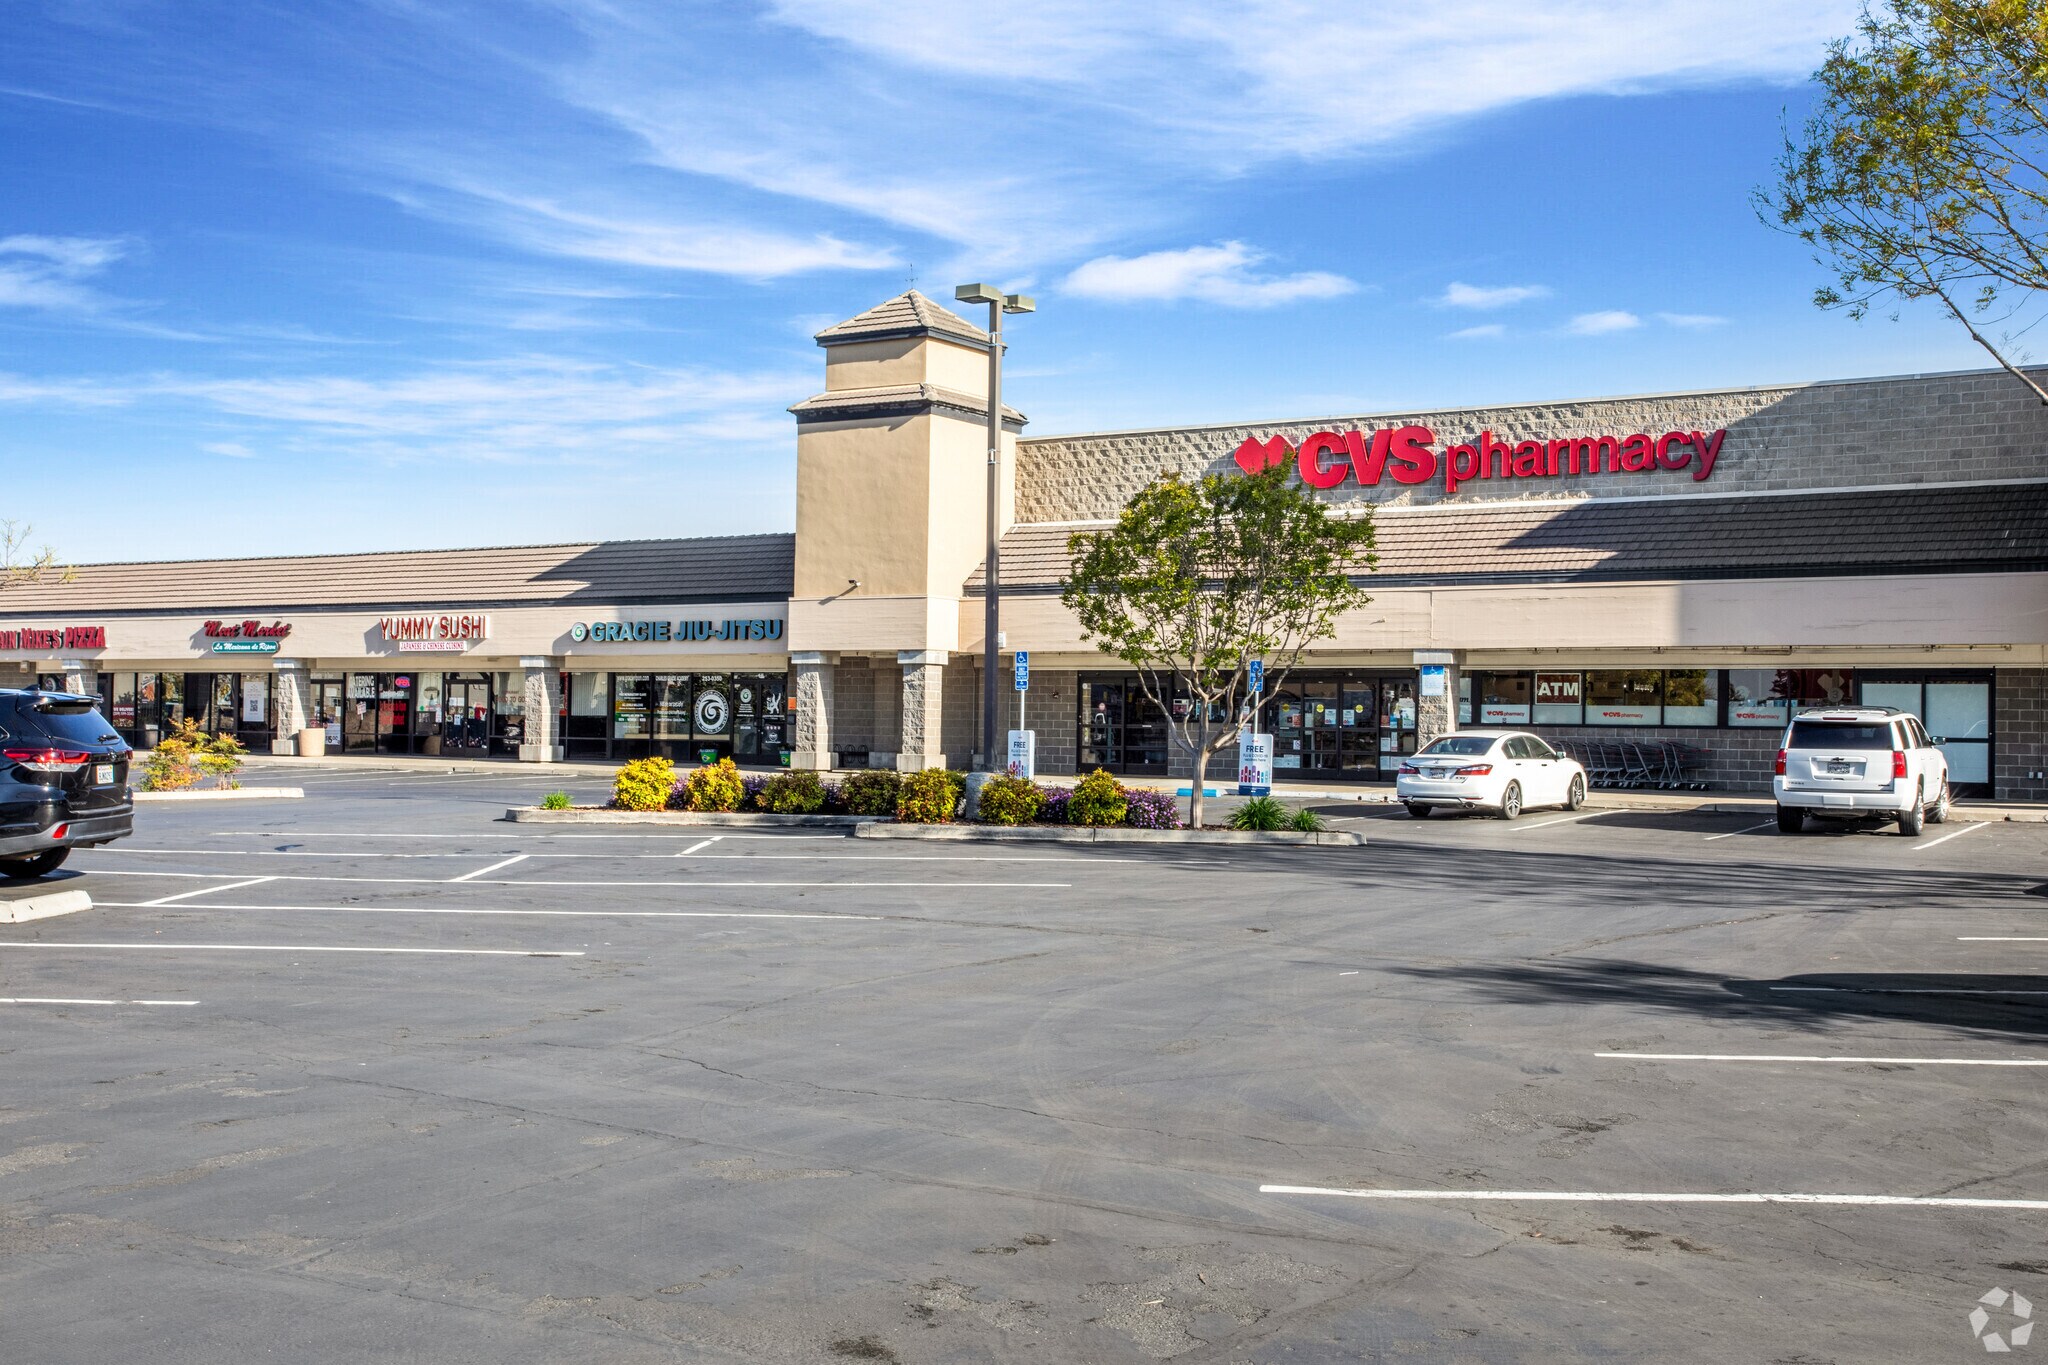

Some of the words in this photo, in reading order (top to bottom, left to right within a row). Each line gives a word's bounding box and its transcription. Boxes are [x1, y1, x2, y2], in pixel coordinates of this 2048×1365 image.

[1300, 425, 1437, 488] CVS
[1446, 429, 1727, 493] pharmacy
[204, 621, 238, 637] Meat
[242, 621, 291, 637] Market
[381, 617, 438, 640] YUMMY
[440, 616, 489, 639] SUSHI
[590, 621, 670, 642] GRACIE
[673, 619, 782, 641] JIU-JITSU
[65, 626, 106, 649] PIZZA
[258, 643, 276, 652] Ripon
[400, 642, 422, 650] JAPANESE
[426, 642, 445, 650] CHINESE
[1537, 682, 1579, 696] ATM
[1245, 745, 1264, 753] FREE
